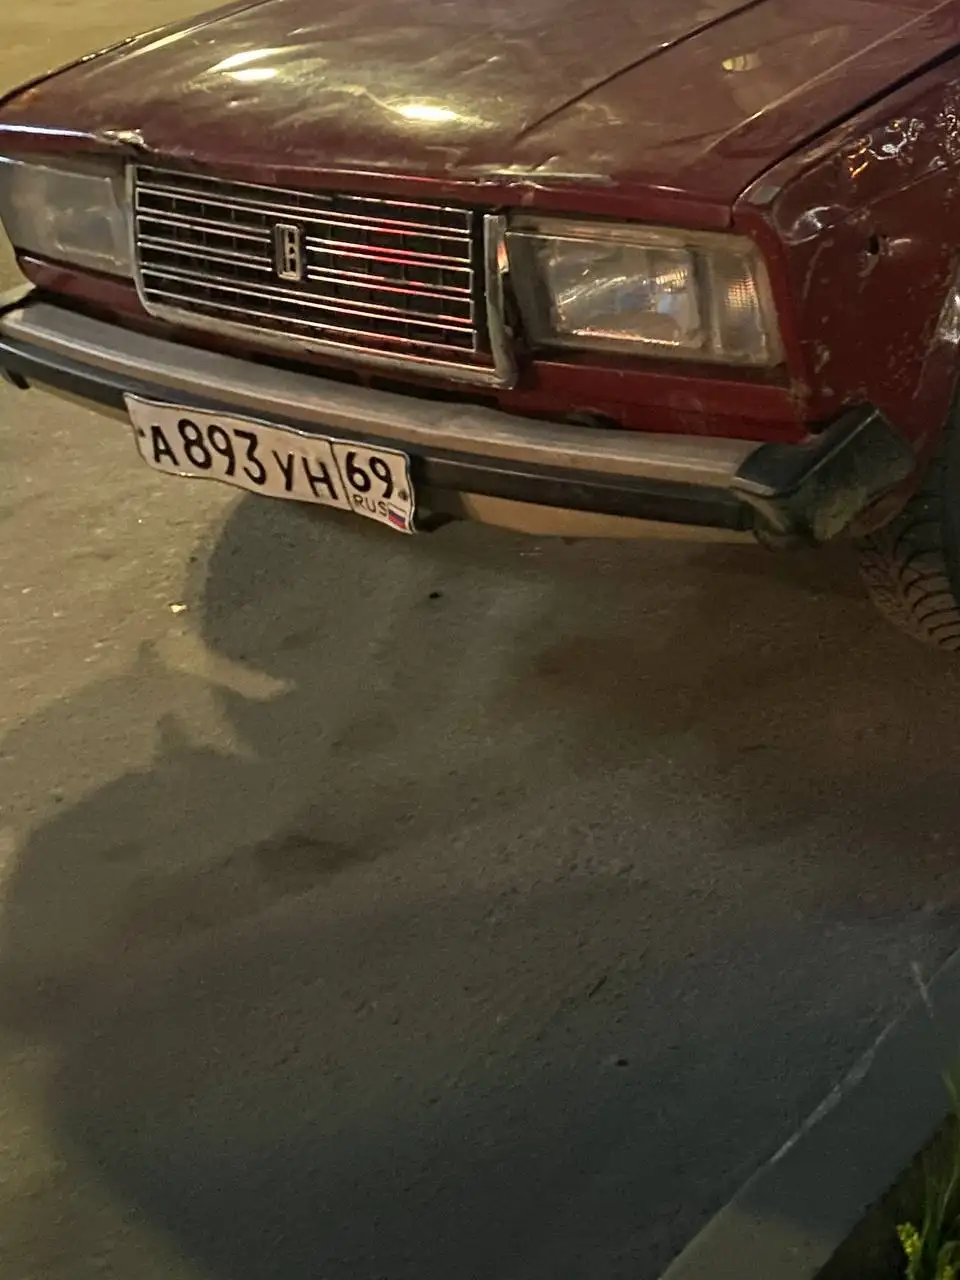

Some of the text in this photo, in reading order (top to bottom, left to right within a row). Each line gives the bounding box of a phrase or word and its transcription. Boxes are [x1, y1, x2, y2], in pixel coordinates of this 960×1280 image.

[150, 418, 395, 501] А893УН 69
[352, 493, 388, 517] RUS
